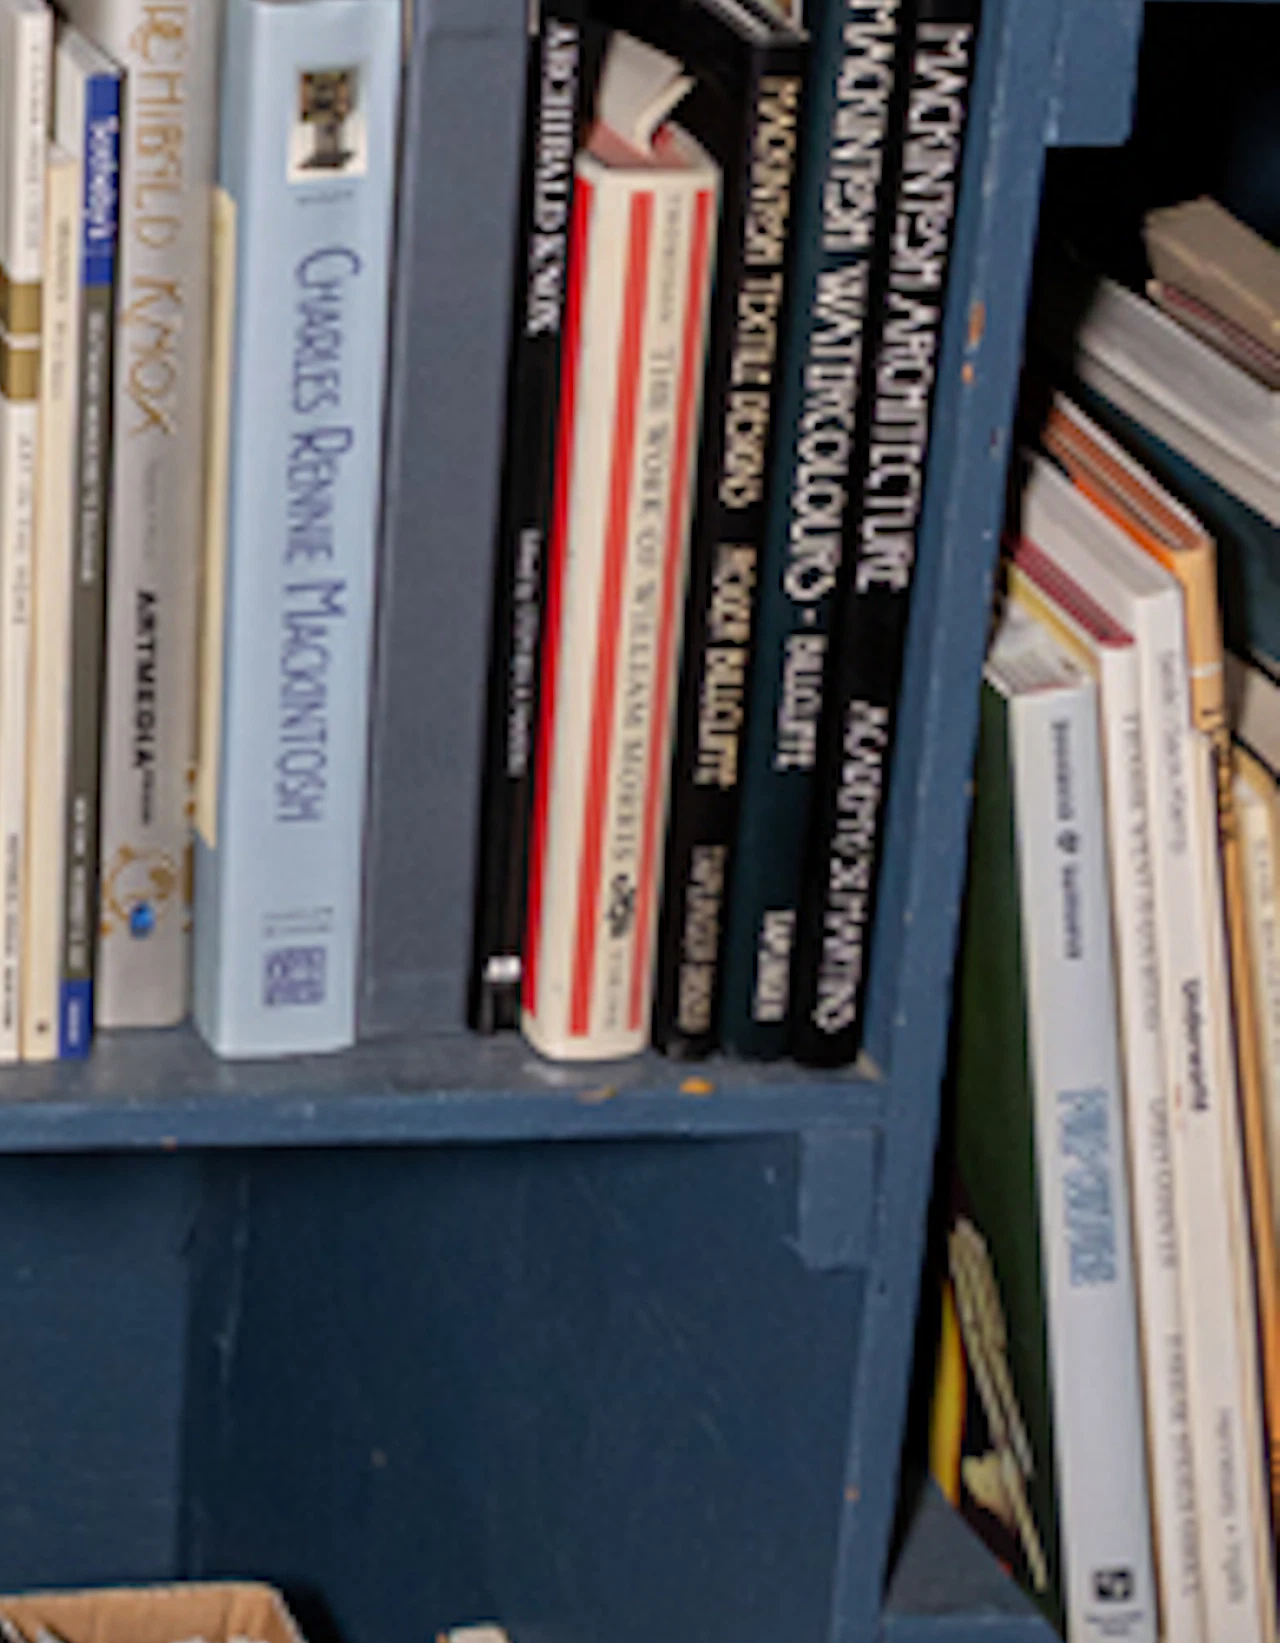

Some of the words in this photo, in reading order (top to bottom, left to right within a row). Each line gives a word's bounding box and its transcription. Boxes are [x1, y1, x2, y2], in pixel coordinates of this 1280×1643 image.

[532, 17, 580, 233] ARCHIBALD
[887, 23, 973, 290] MACKINTOSH
[289, 247, 361, 413] CHARLES
[526, 235, 566, 335] KNOX
[285, 425, 354, 564] RENNIE
[856, 293, 935, 594] ARCHITECTURE
[130, 589, 158, 769] ARTMEDIA
[274, 578, 346, 823] MACKINTOSH
